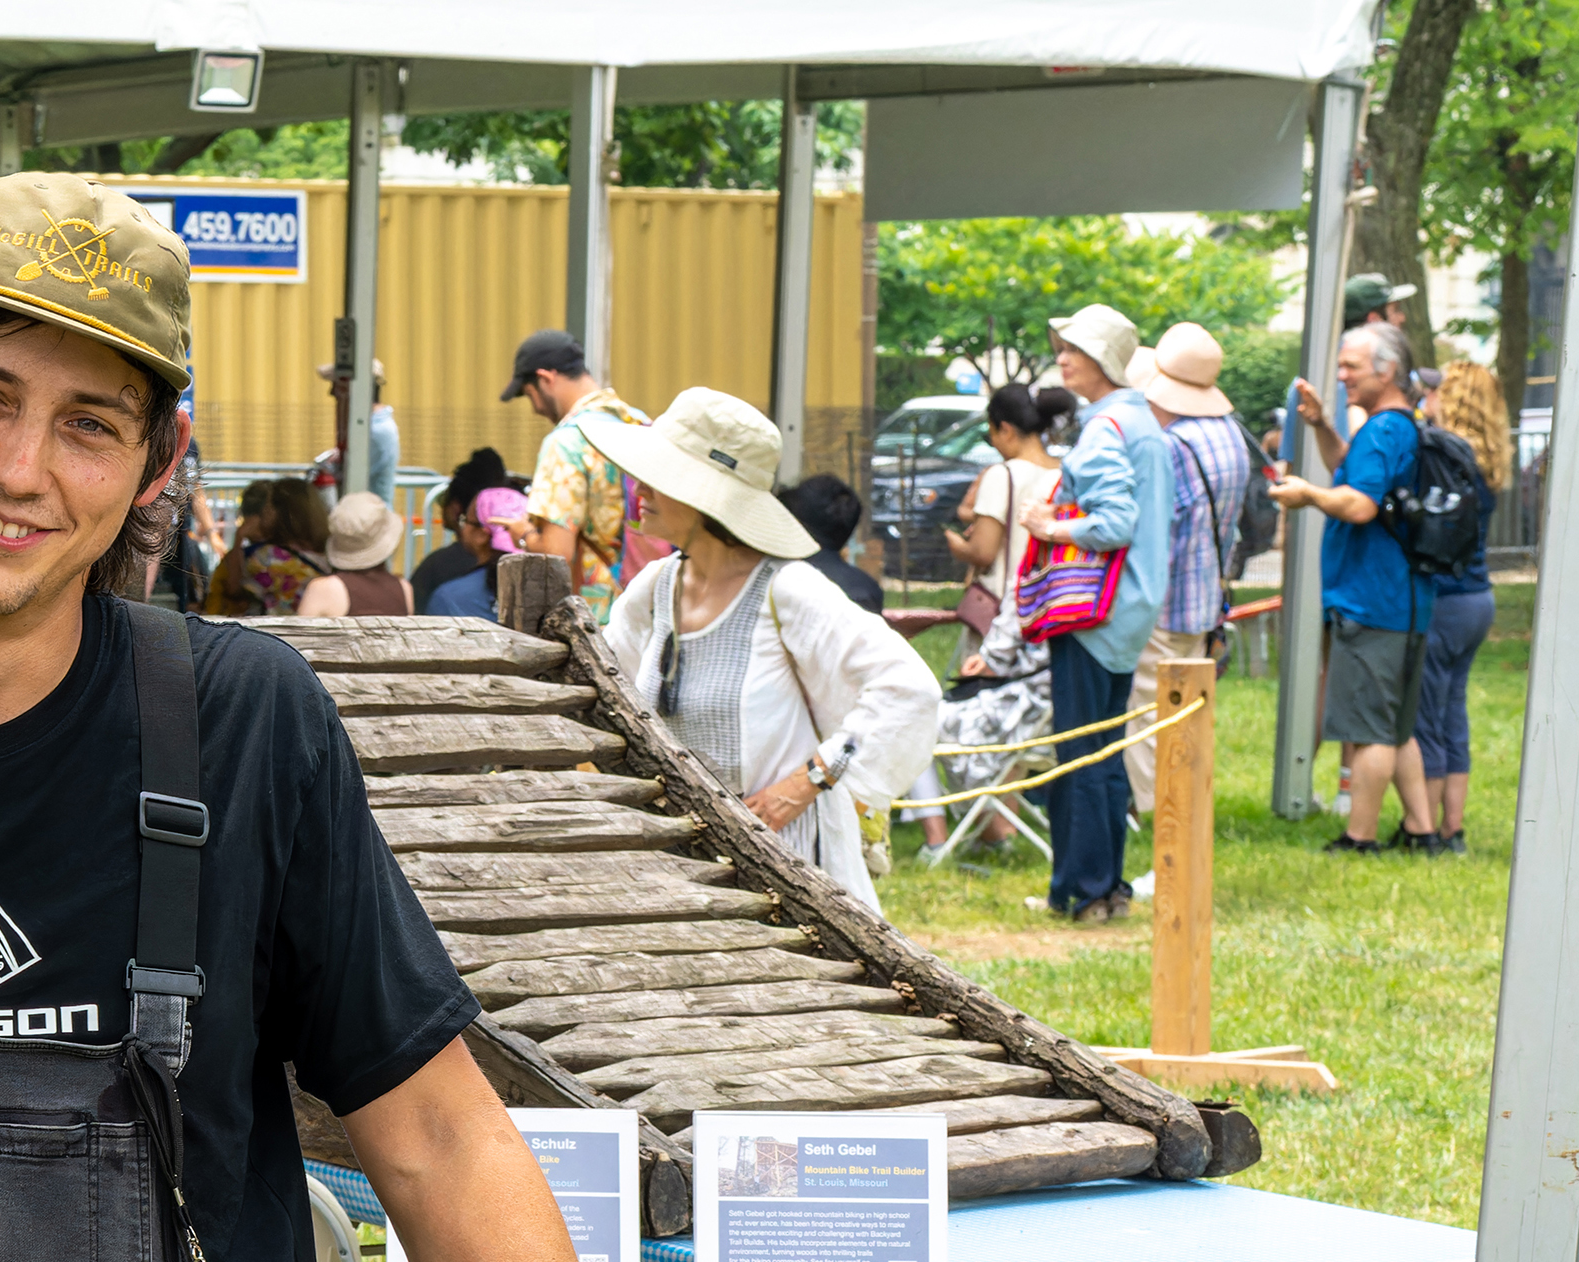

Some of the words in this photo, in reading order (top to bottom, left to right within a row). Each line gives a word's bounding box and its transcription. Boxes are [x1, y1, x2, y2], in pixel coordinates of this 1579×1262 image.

[84, 248, 152, 293] TRAILS
[531, 1138, 576, 1150] Schulz
[804, 1143, 834, 1155] Seth
[838, 1144, 876, 1156] Gebel
[539, 1155, 560, 1163] Bike
[804, 1166, 847, 1174] Mountain
[849, 1166, 869, 1175] Bike
[871, 1167, 891, 1175] Trail
[893, 1167, 926, 1175] Builder
[548, 1179, 579, 1187] issouri
[804, 1178, 817, 1186] St.
[819, 1178, 847, 1188] Louis,
[849, 1179, 888, 1187] Missouri
[728, 1209, 744, 1217] Seth
[845, 1212, 865, 1220] biking
[873, 1212, 887, 1220] high
[811, 1221, 833, 1229] finding
[777, 1230, 803, 1238] exciting
[817, 1230, 854, 1238] challenging
[870, 1231, 901, 1239] Backyard
[771, 1248, 795, 1257] turning
[832, 1250, 856, 1258] thrilling
